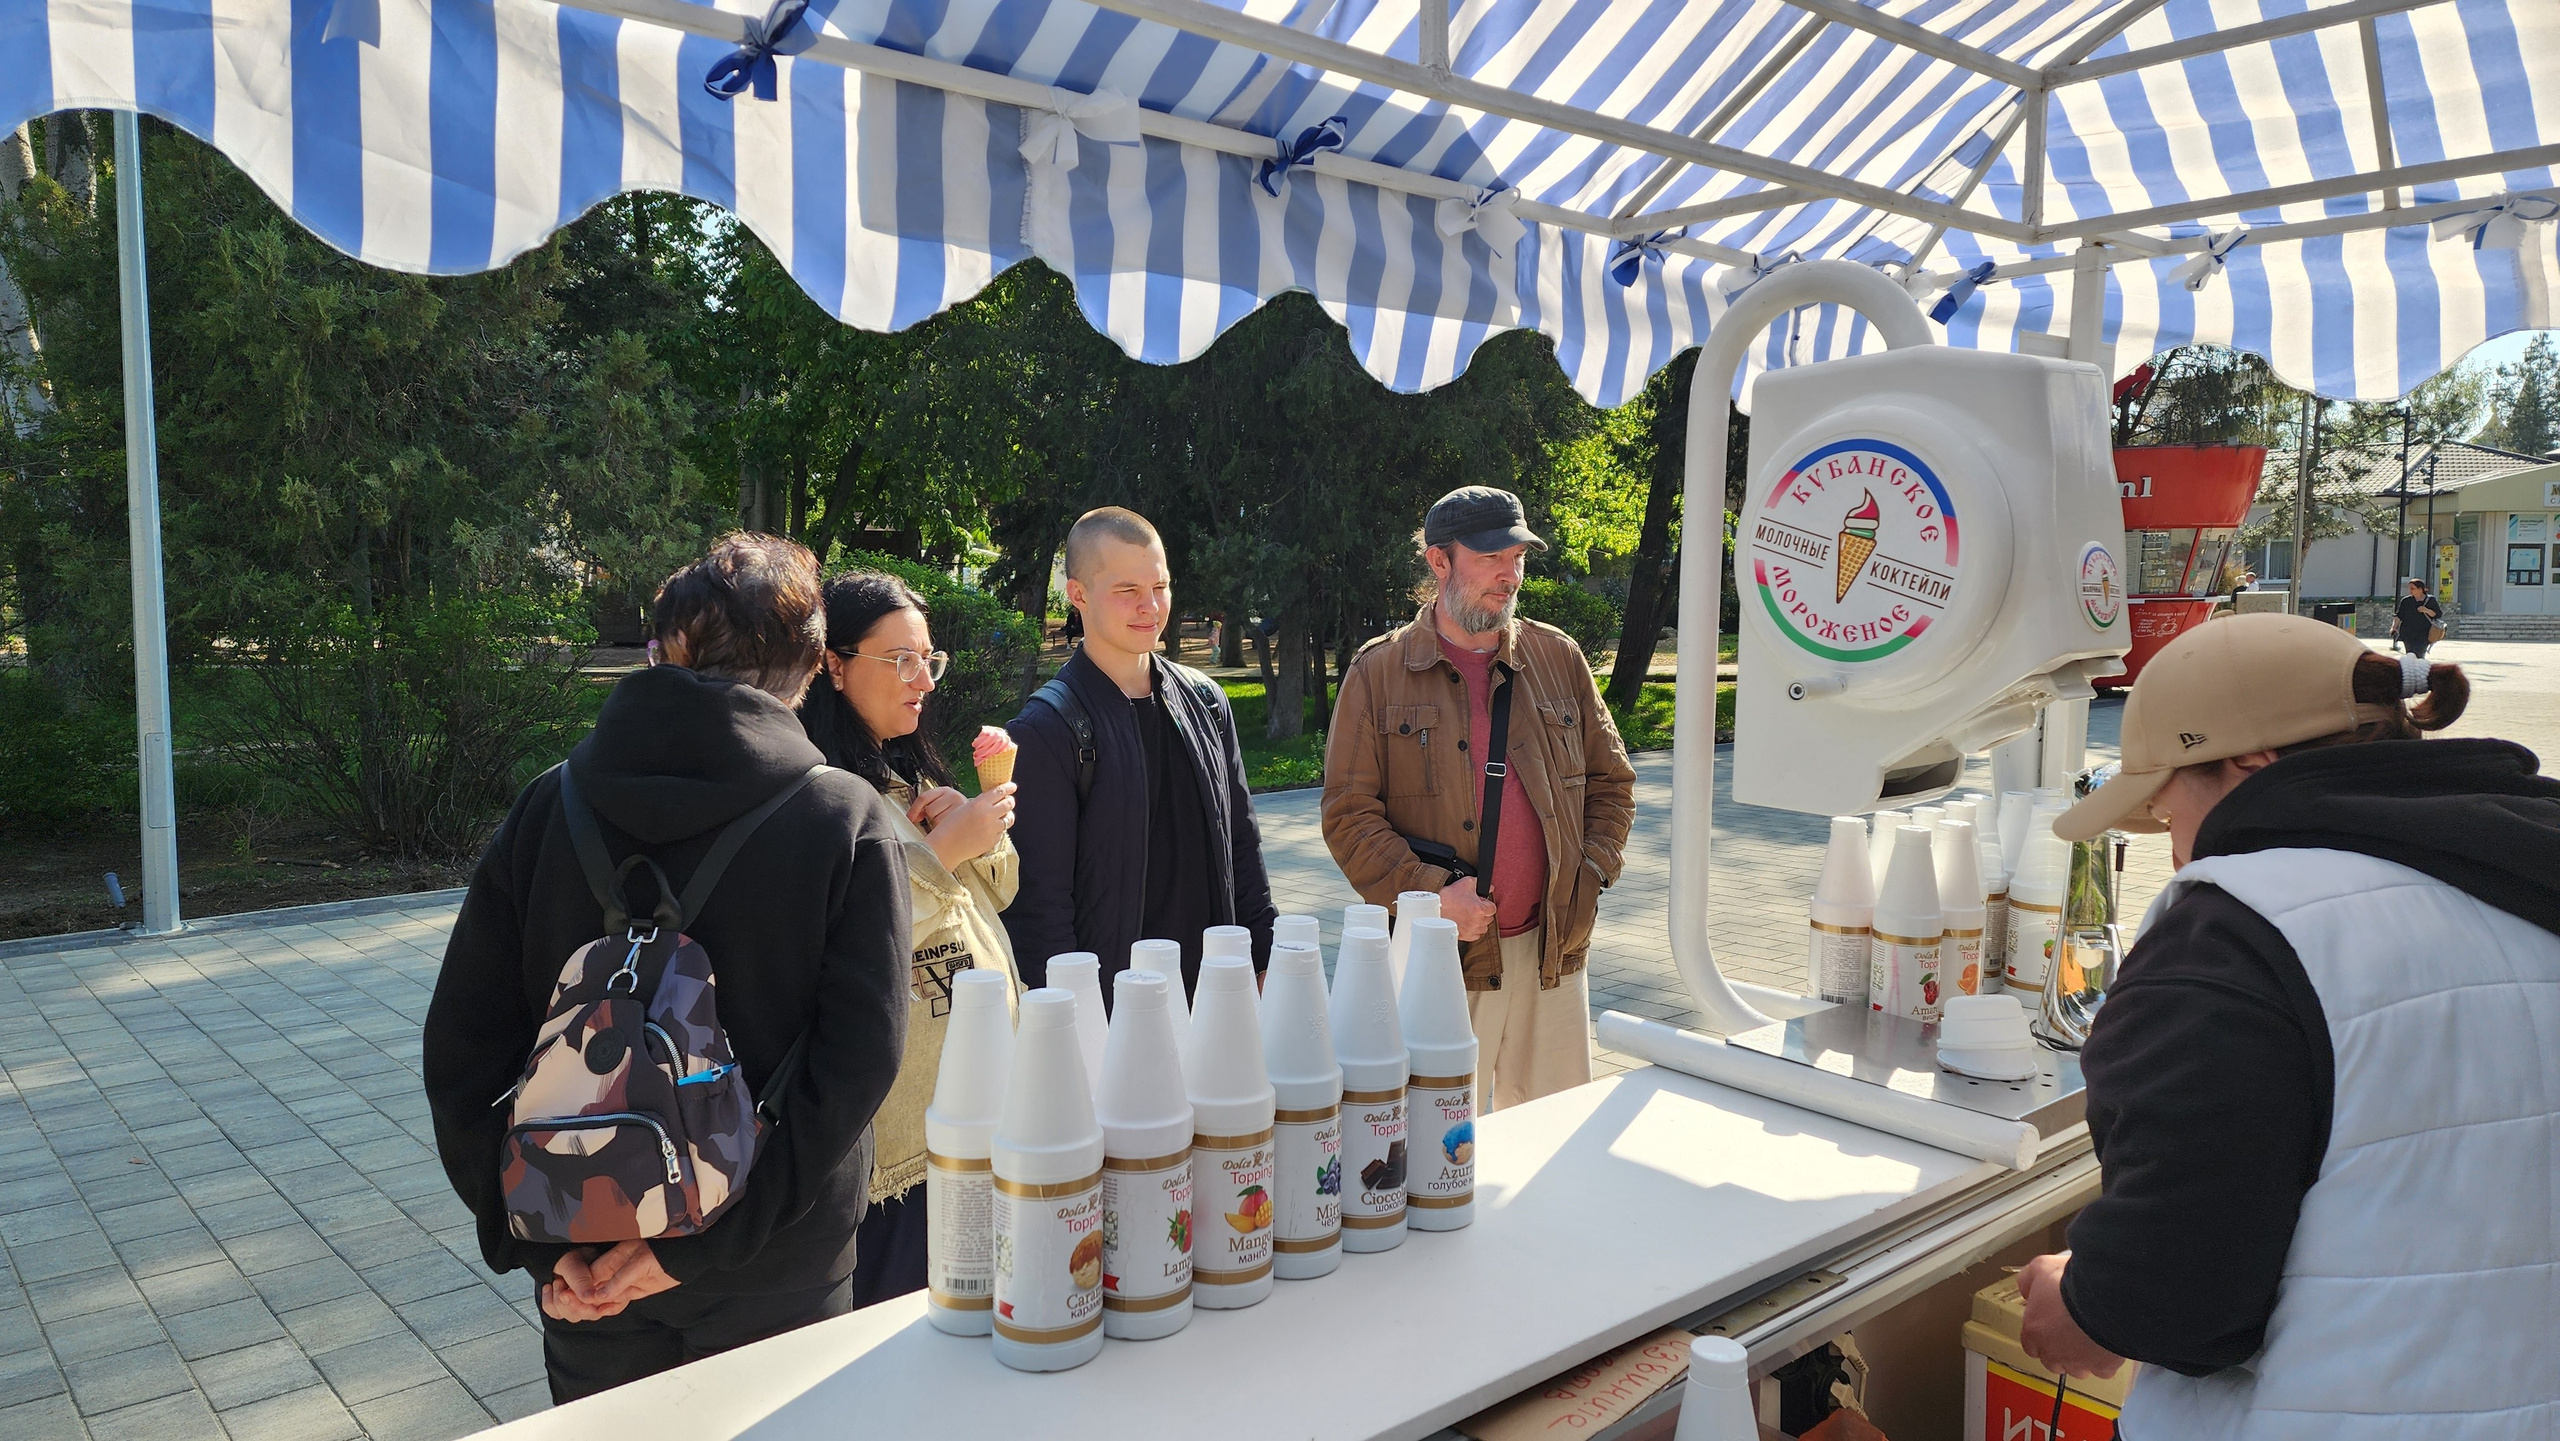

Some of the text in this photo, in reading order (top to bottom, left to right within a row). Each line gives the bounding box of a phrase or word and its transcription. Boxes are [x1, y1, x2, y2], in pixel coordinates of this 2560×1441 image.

[1791, 455, 1939, 542] КУБАНСКОЕ
[1755, 524, 1952, 601] МОЛОЧНЫЕ КОКТЕЙЛИ
[1773, 566, 1910, 643] МОРОЖЕНОЕ
[1434, 1095, 1461, 1107] Dolce
[1363, 1111, 1391, 1123] Dolce
[1222, 1157, 1252, 1170] Dolce
[1161, 1173, 1186, 1190] Dolce
[1230, 1164, 1273, 1186] Topping
[1428, 1178, 1468, 1193] голубое
[1057, 1202, 1087, 1219] Dolce
[1228, 1230, 1272, 1253] Mango
[1238, 1247, 1267, 1264] манго
